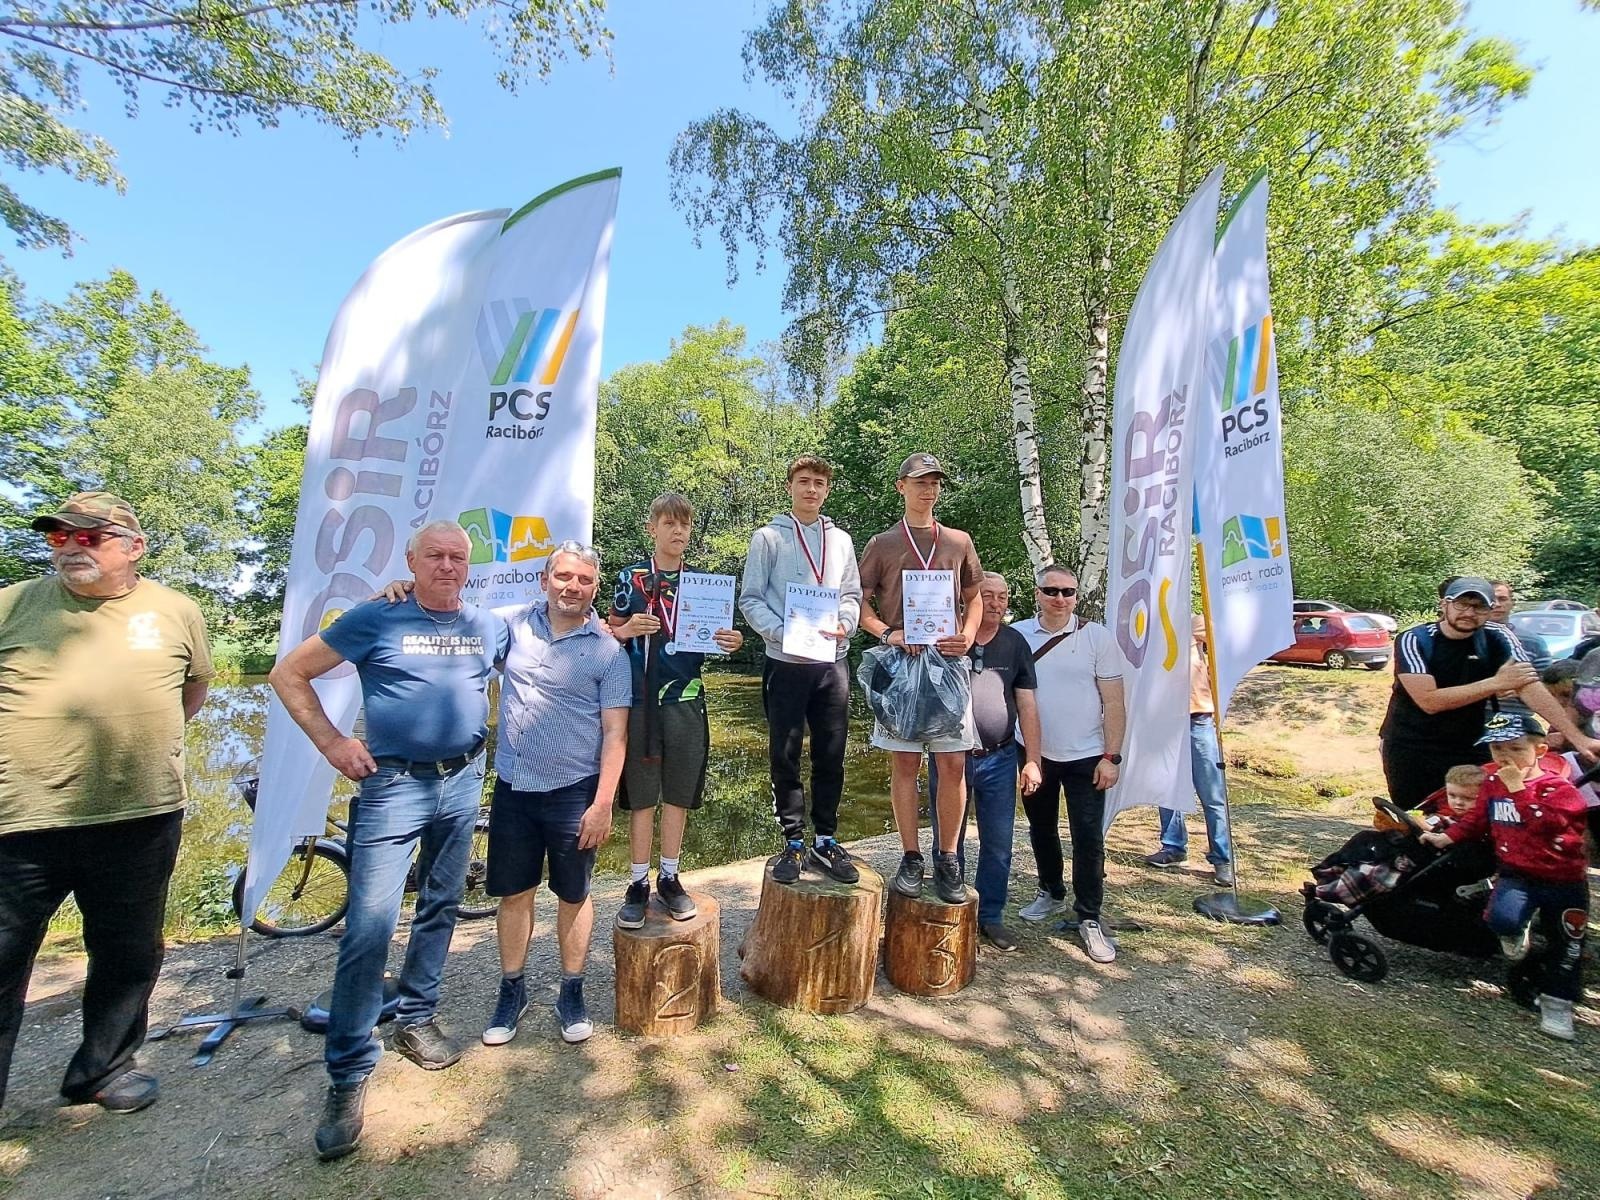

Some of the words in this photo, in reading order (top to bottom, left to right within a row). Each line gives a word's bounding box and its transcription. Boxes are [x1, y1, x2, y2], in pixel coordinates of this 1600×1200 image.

[488, 389, 552, 421] PCS
[485, 425, 545, 440] Racibórz
[1222, 398, 1269, 443] PCS
[1224, 432, 1271, 458] Racibórz
[405, 390, 452, 556] ACIBÓRZ
[683, 576, 733, 588] DYPLOM
[905, 574, 951, 582] DYPLOM
[1221, 570, 1253, 589] powiat
[1258, 563, 1285, 579] racib
[789, 586, 837, 600] DYPLOM
[402, 635, 449, 646] REALITY
[450, 636, 460, 646] IS
[461, 636, 482, 646] NOT
[403, 645, 440, 655] WHAT
[441, 646, 452, 655] IT
[454, 646, 484, 655] SEEMS
[921, 919, 962, 990] 3
[651, 942, 703, 1022] 2
